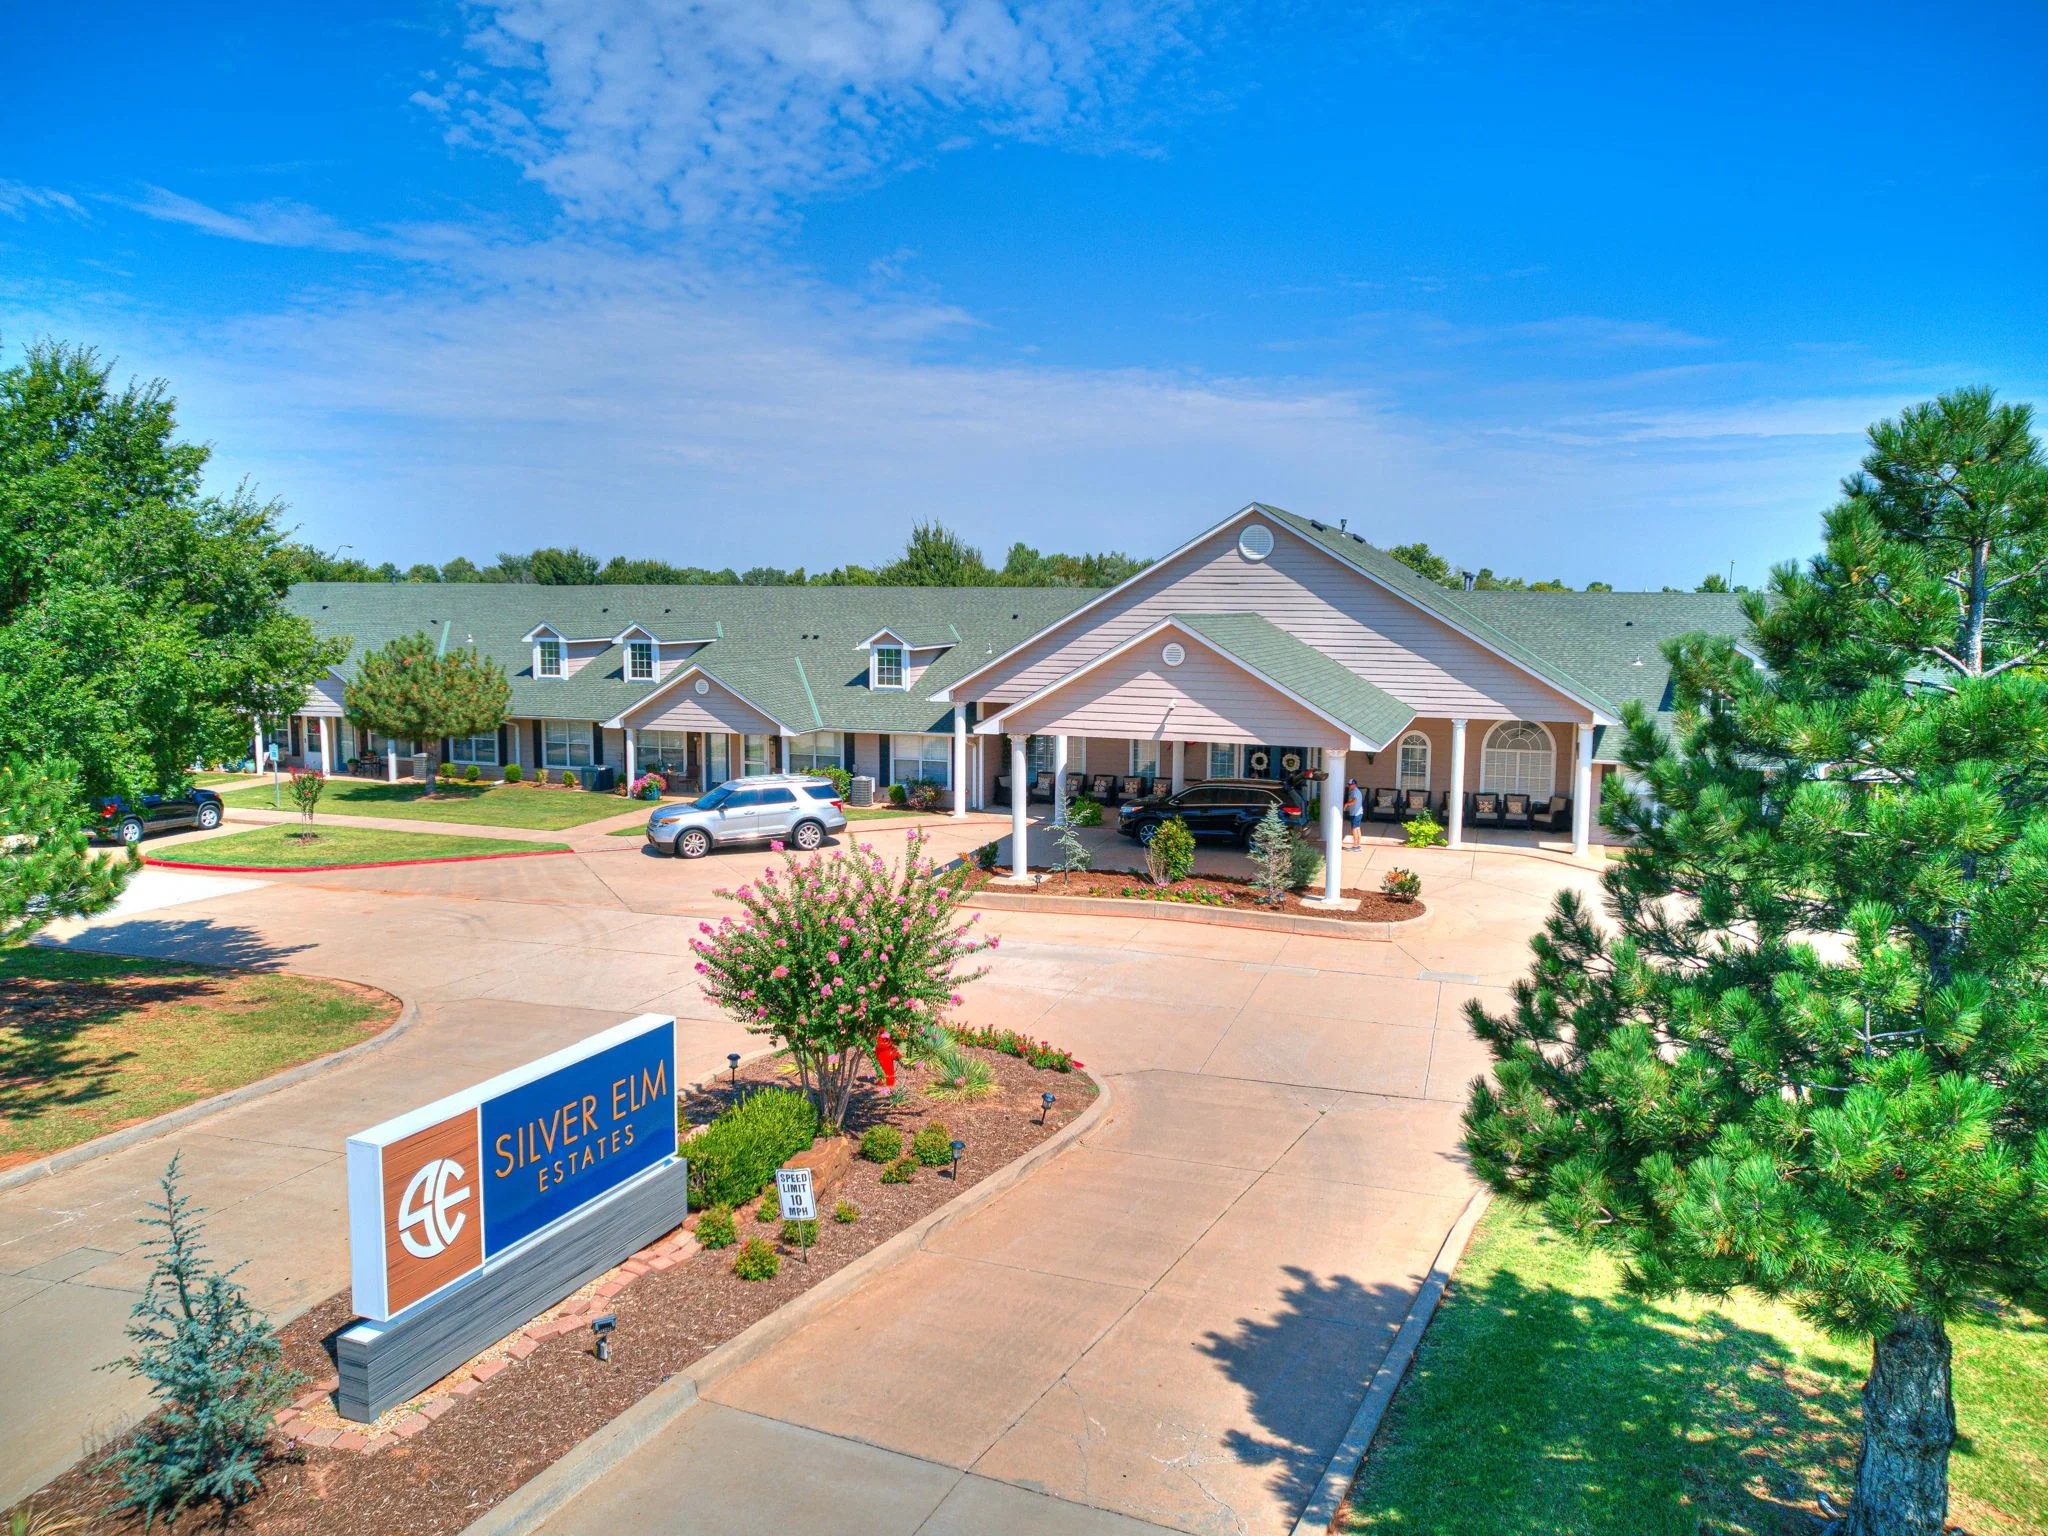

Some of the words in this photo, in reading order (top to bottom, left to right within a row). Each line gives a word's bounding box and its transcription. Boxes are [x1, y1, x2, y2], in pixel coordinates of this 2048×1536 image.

[495, 1096, 598, 1178] SILVER
[612, 1059, 667, 1120] ELM
[538, 1124, 634, 1193] ESTATES
[780, 1173, 807, 1182] SPEED
[783, 1184, 806, 1192] LIMIT
[790, 1195, 802, 1205] 10
[788, 1207, 808, 1216] MPH
